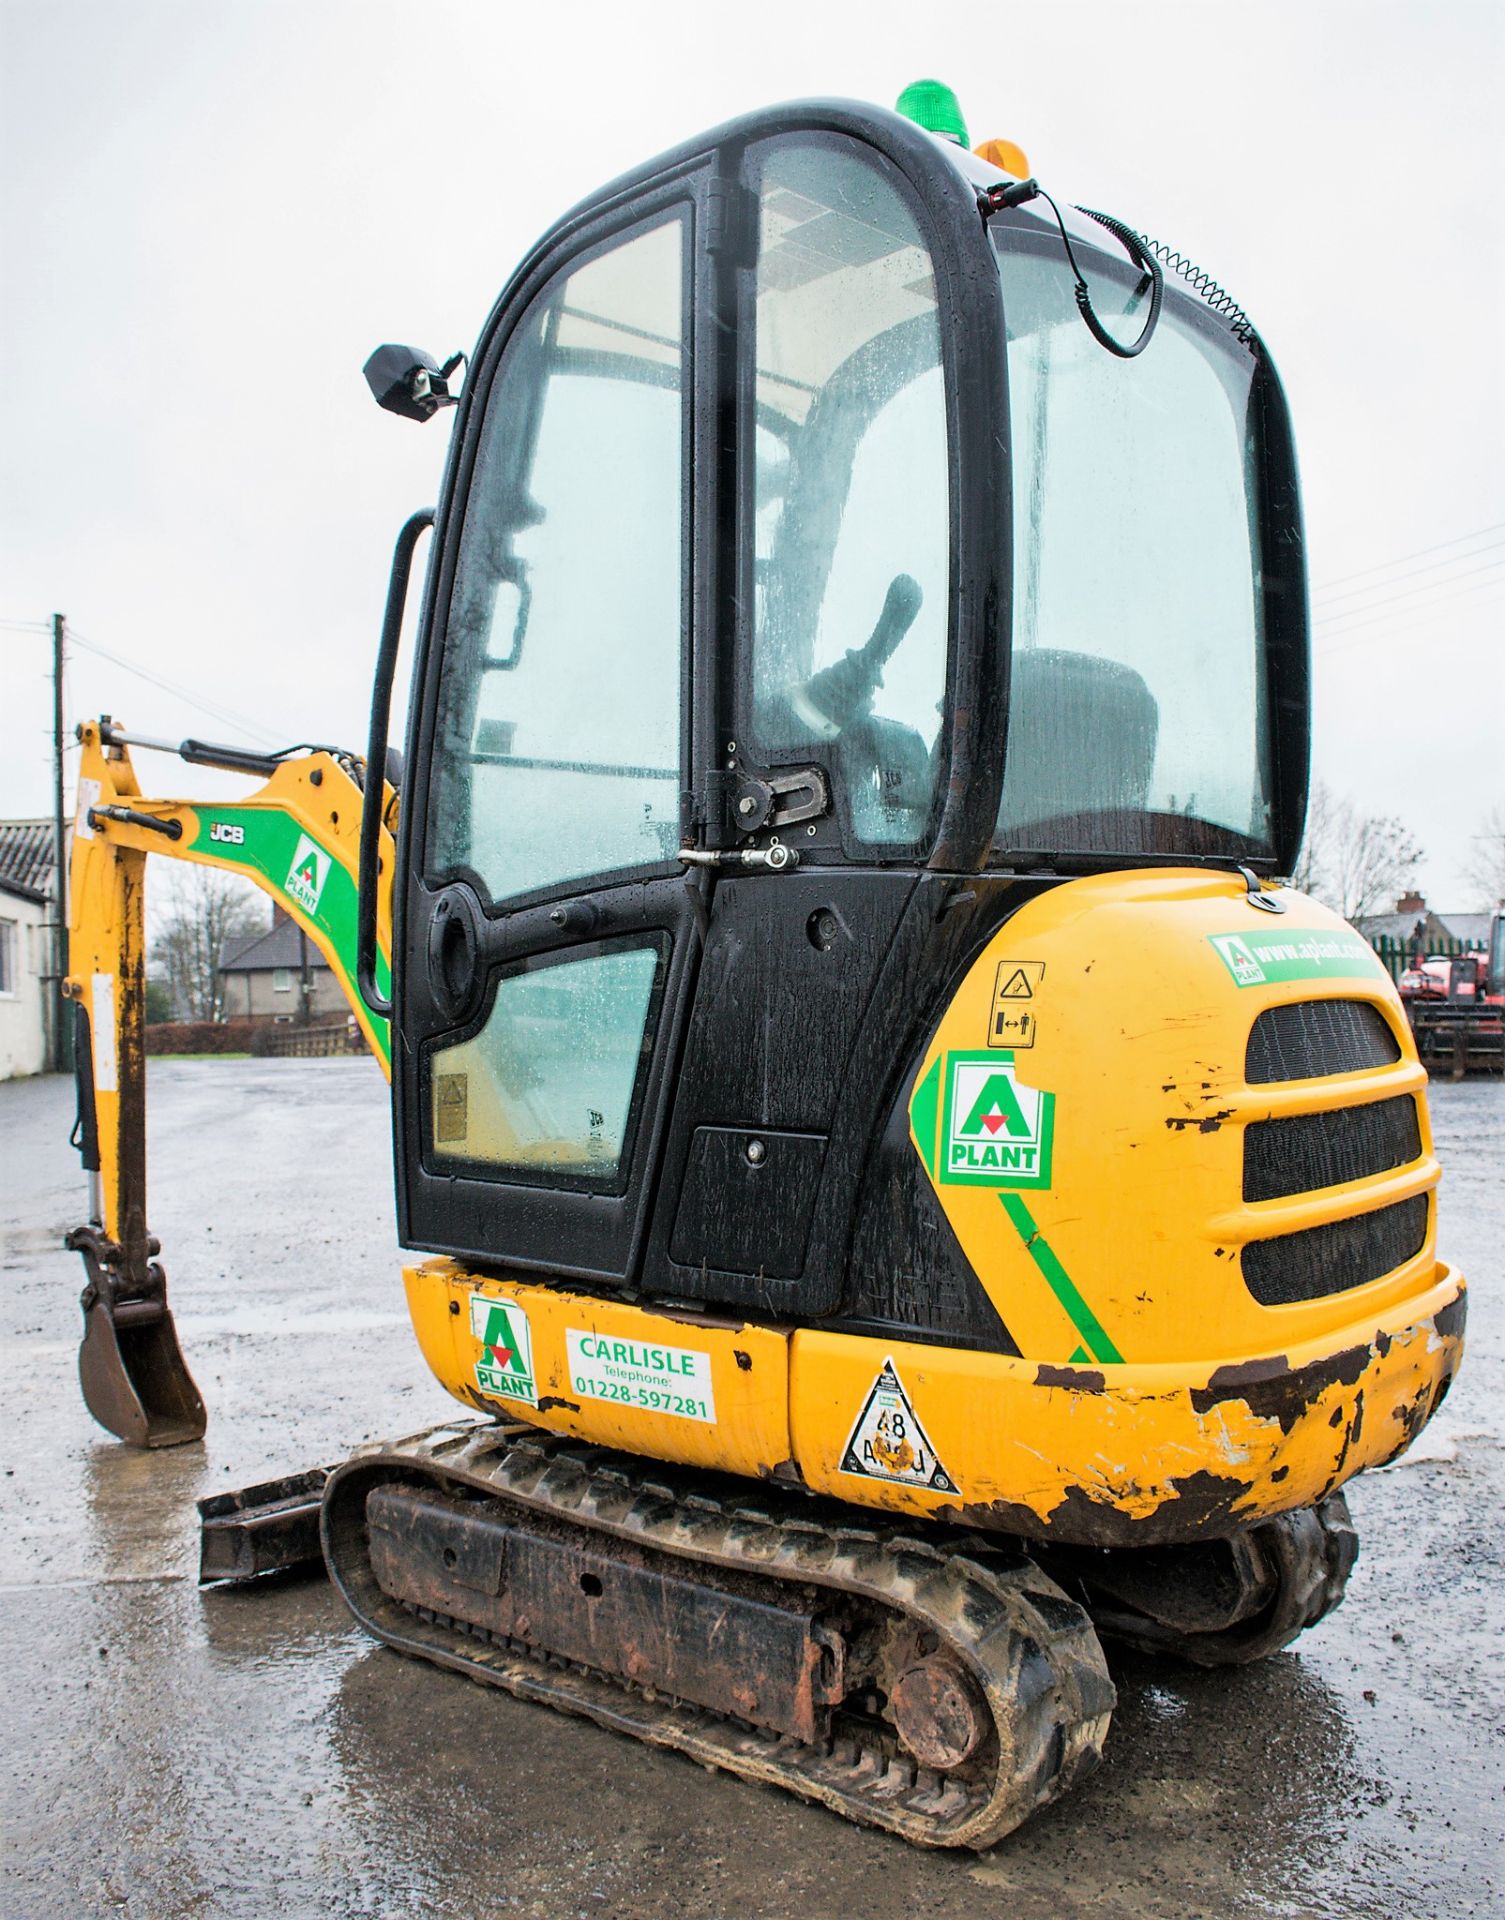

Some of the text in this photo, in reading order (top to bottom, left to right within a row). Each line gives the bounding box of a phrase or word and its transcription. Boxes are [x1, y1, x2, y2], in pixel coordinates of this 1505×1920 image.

[210, 823, 245, 845] JCB
[294, 851, 318, 893] A
[287, 876, 317, 908] PLANT
[1226, 941, 1254, 968] A
[959, 1073, 1032, 1137] A
[951, 1144, 1037, 1170] PLANT
[480, 1306, 527, 1375] A
[579, 1337, 696, 1377] CARLISLE
[477, 1370, 535, 1399] PLANT
[602, 1364, 672, 1388] Telephone:
[576, 1376, 707, 1418] 01228-597281
